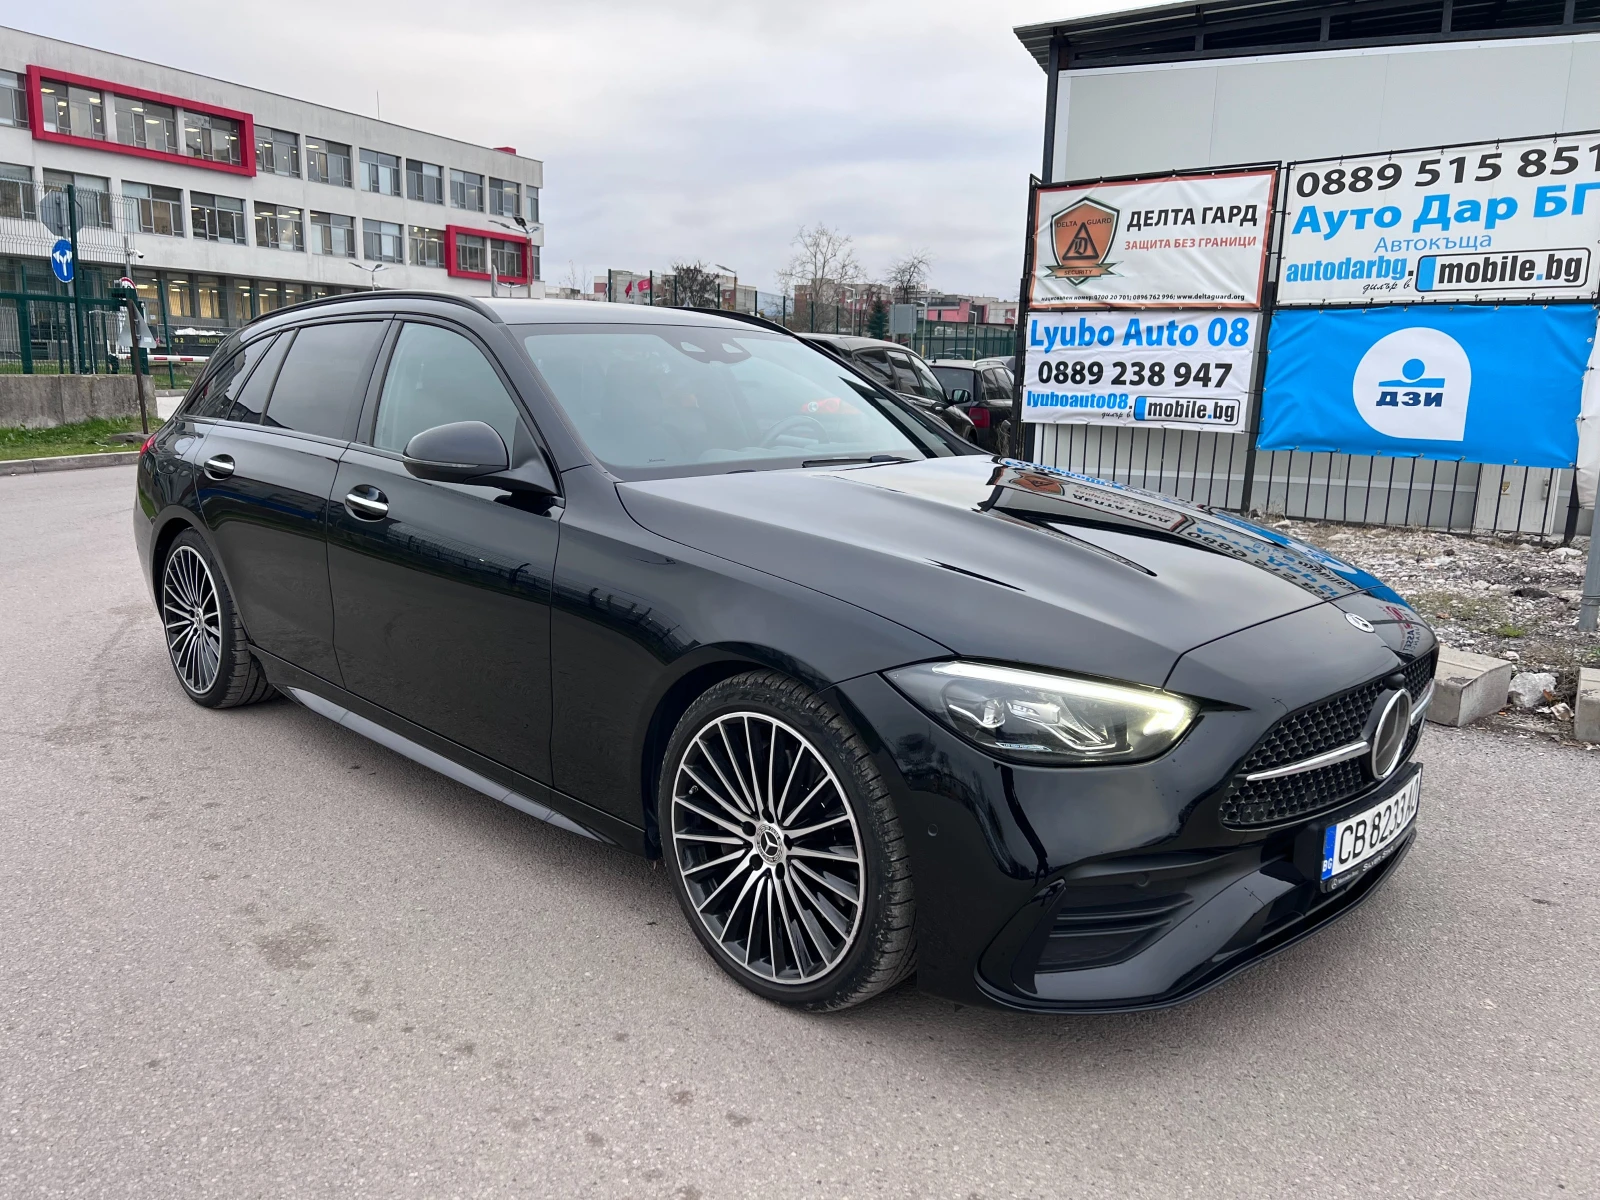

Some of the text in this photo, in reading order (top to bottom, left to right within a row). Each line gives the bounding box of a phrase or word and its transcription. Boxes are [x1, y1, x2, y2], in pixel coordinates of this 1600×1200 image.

[1296, 163, 1402, 198] 0889
[1414, 152, 1502, 188] 515
[1086, 217, 1112, 226] GUARD
[1126, 204, 1258, 232] ДЕЛТА ГАРД
[1291, 182, 1600, 240] Ауто Дар БГ
[1124, 236, 1257, 252] ЗАЩИТА БЕЗ ГРАНИЦИ
[1373, 233, 1493, 254] Автокъща
[1437, 253, 1583, 284] mobile.bg
[1176, 293, 1245, 301] www.deltaguard.org
[1362, 282, 1398, 295] дилър
[1030, 317, 1249, 353] Lyubo Auto 08
[1038, 360, 1233, 388] 0889 238 947
[1147, 400, 1236, 423] mobile.bg
[1338, 819, 1367, 865] CB
[1369, 792, 1406, 849] 8233
[1322, 857, 1333, 872] BG
